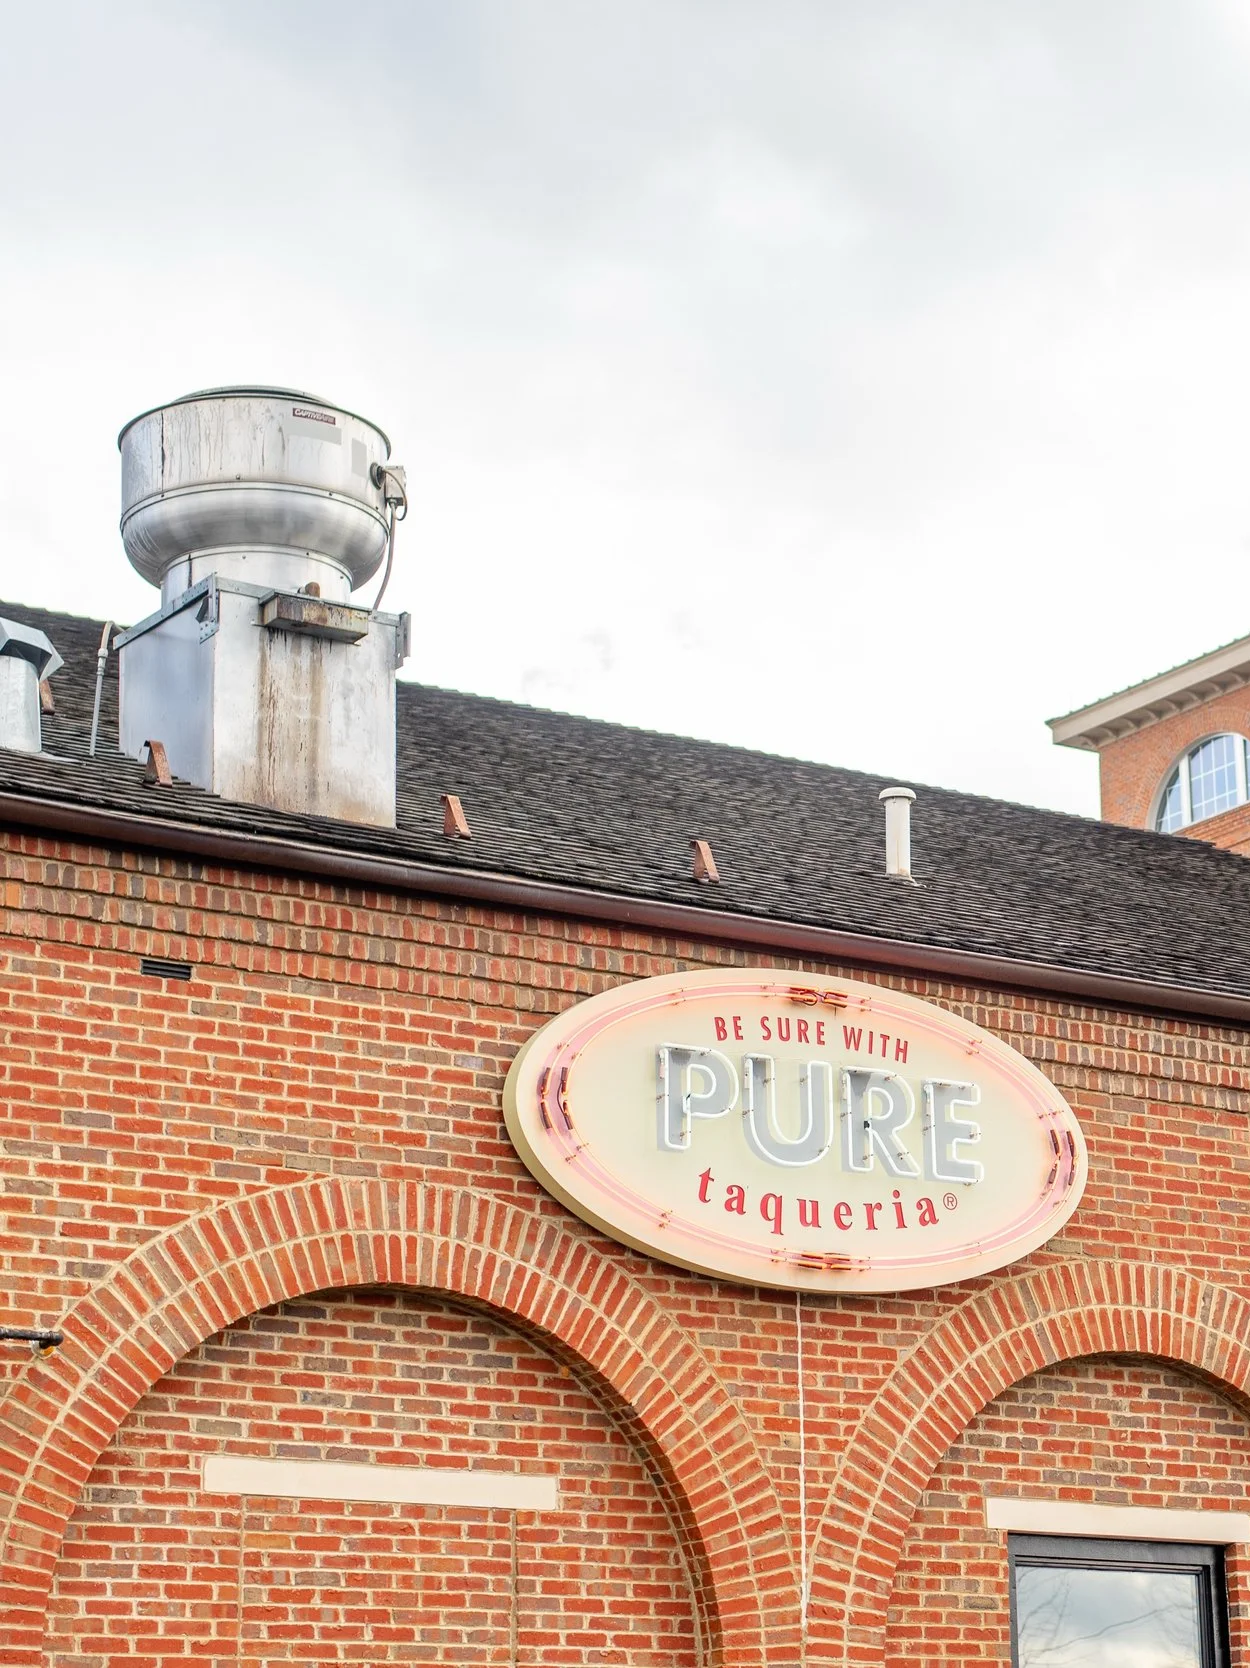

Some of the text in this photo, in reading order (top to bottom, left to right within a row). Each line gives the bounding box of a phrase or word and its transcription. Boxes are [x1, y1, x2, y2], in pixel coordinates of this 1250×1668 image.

[714, 1016, 909, 1064] BE SURE WITH
[655, 1042, 985, 1185] PURE
